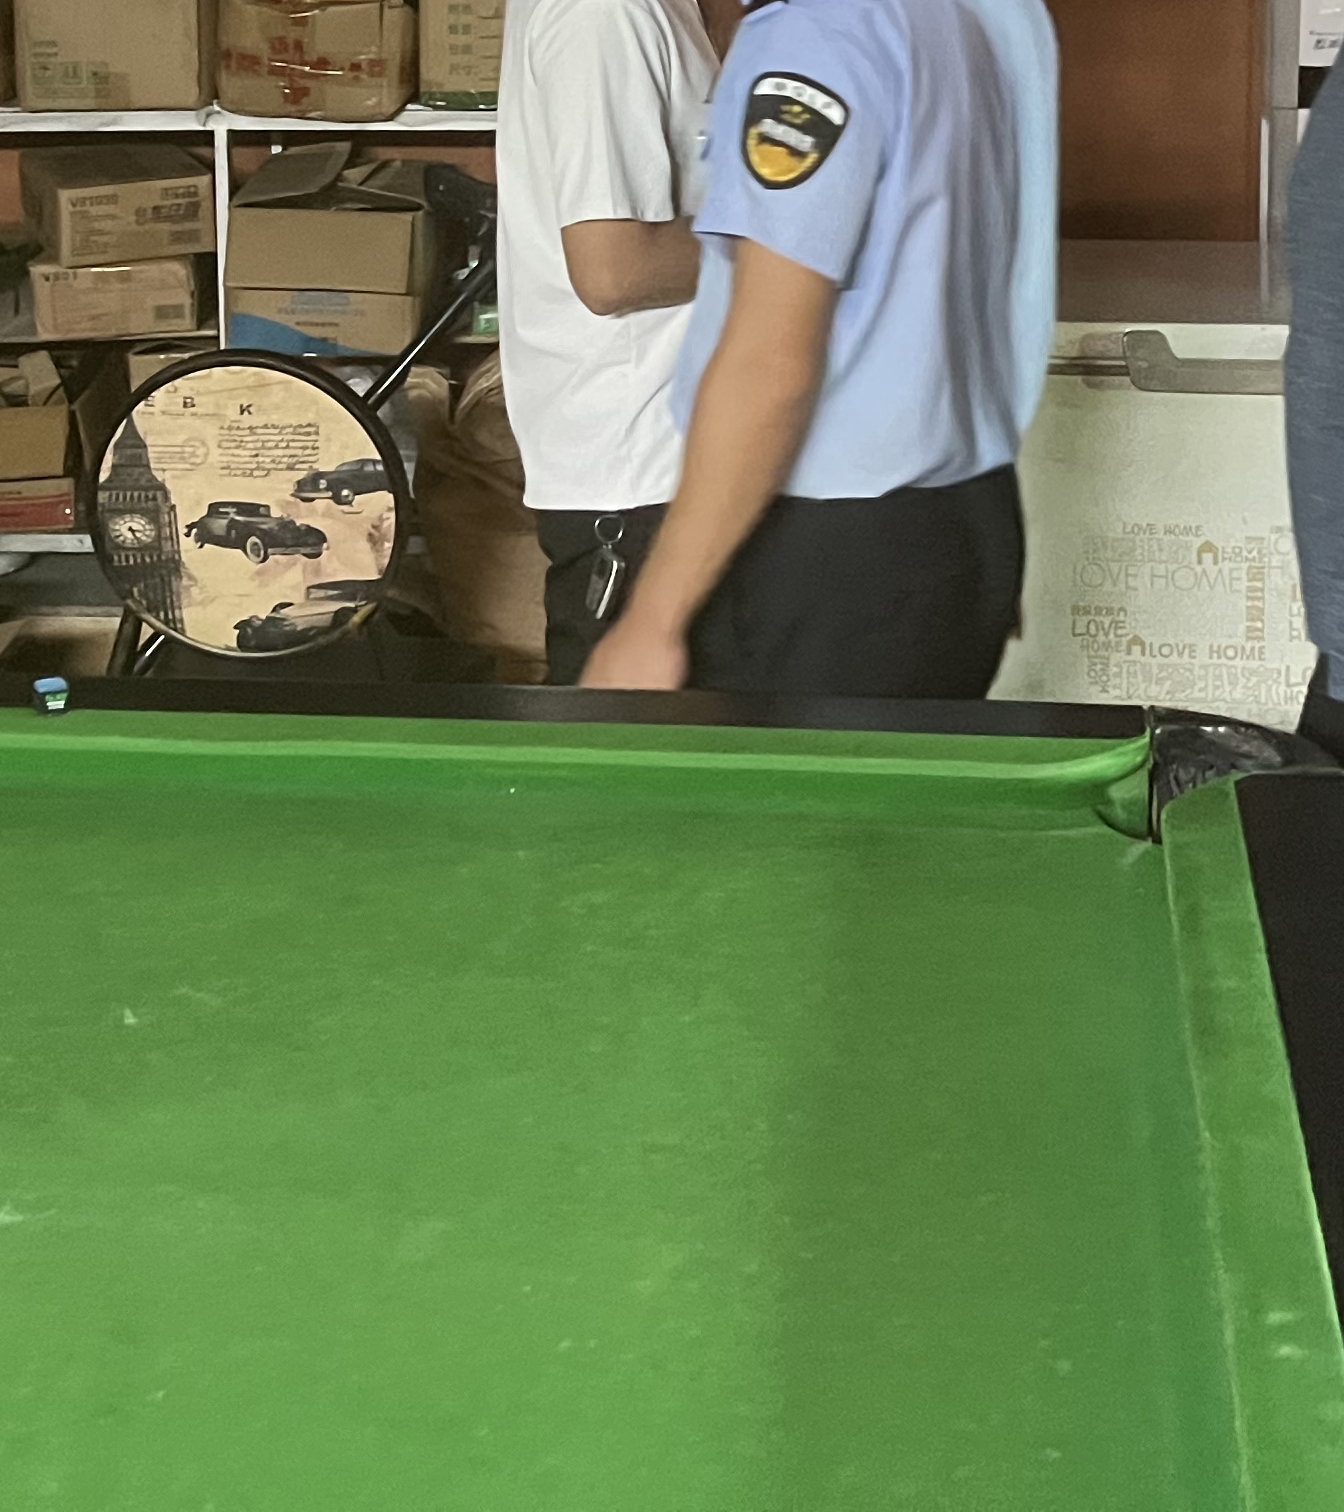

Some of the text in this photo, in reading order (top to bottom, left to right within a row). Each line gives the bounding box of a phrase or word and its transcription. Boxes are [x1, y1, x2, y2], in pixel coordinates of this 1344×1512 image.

[1122, 522, 1204, 537] LOVE HOME
[1073, 562, 1243, 593] LOVE HOME
[1072, 618, 1129, 638] LOVE
[1149, 642, 1266, 661] LOVE HOME
